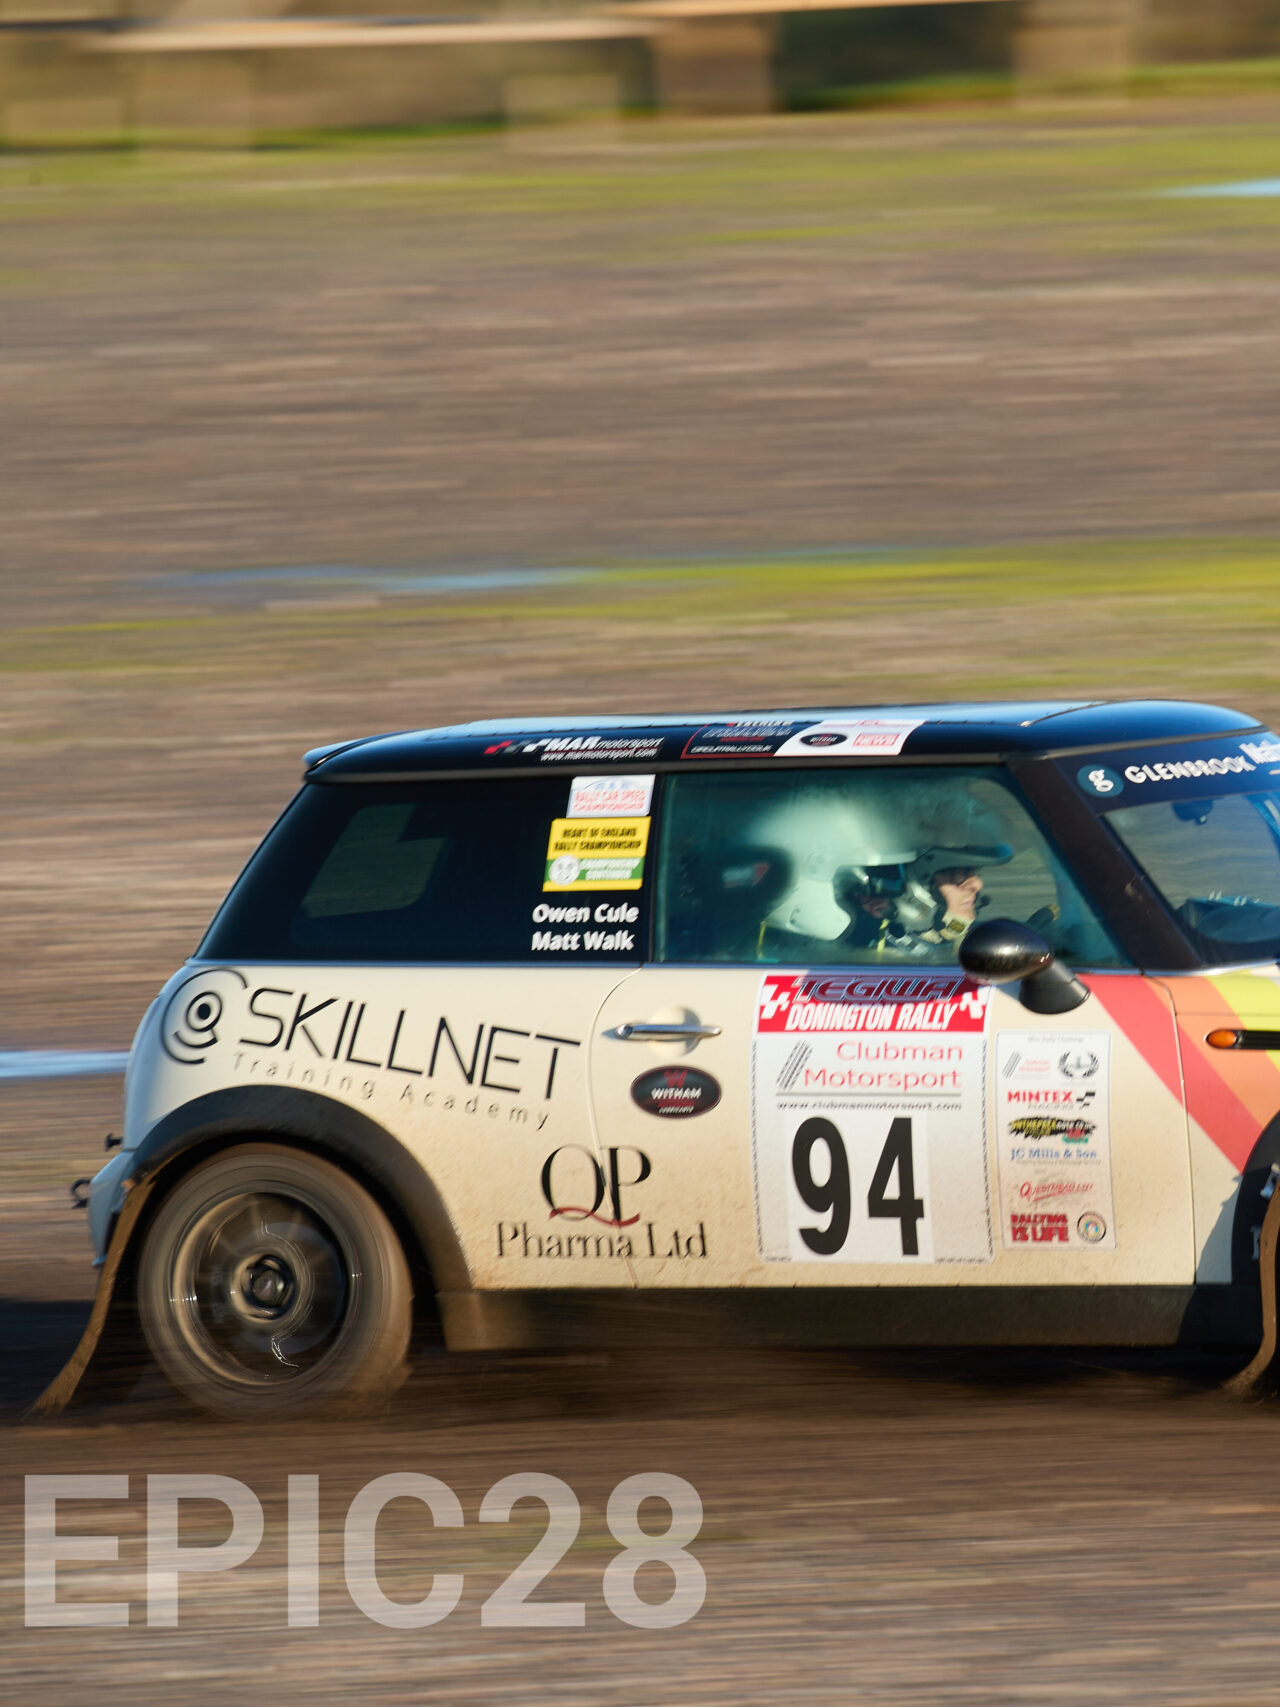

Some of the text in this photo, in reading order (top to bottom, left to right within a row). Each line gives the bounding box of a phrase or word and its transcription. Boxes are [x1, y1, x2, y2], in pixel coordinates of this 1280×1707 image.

[1124, 755, 1257, 784] GLENBROOK
[532, 902, 640, 923] Owen Cule
[531, 929, 636, 950] Matt Walk
[785, 1002, 960, 1032] DONINGTON RALLY
[238, 986, 581, 1100] SKILLNET
[836, 1040, 963, 1062] Clubman
[804, 1067, 962, 1092] Motorsport
[234, 1052, 551, 1131] Training Academy
[651, 1087, 702, 1100] WITHAM
[1007, 1090, 1073, 1103] MINTEX
[776, 1101, 963, 1112] www.clubmanmotorsport.com
[1010, 1148, 1026, 1161] JC
[1028, 1148, 1060, 1159] Mills
[1063, 1148, 1073, 1159] &
[540, 1143, 653, 1228] QP
[792, 1116, 925, 1257] 94
[494, 1220, 710, 1259] Pharma Ltd
[1031, 1226, 1069, 1242] LIFE
